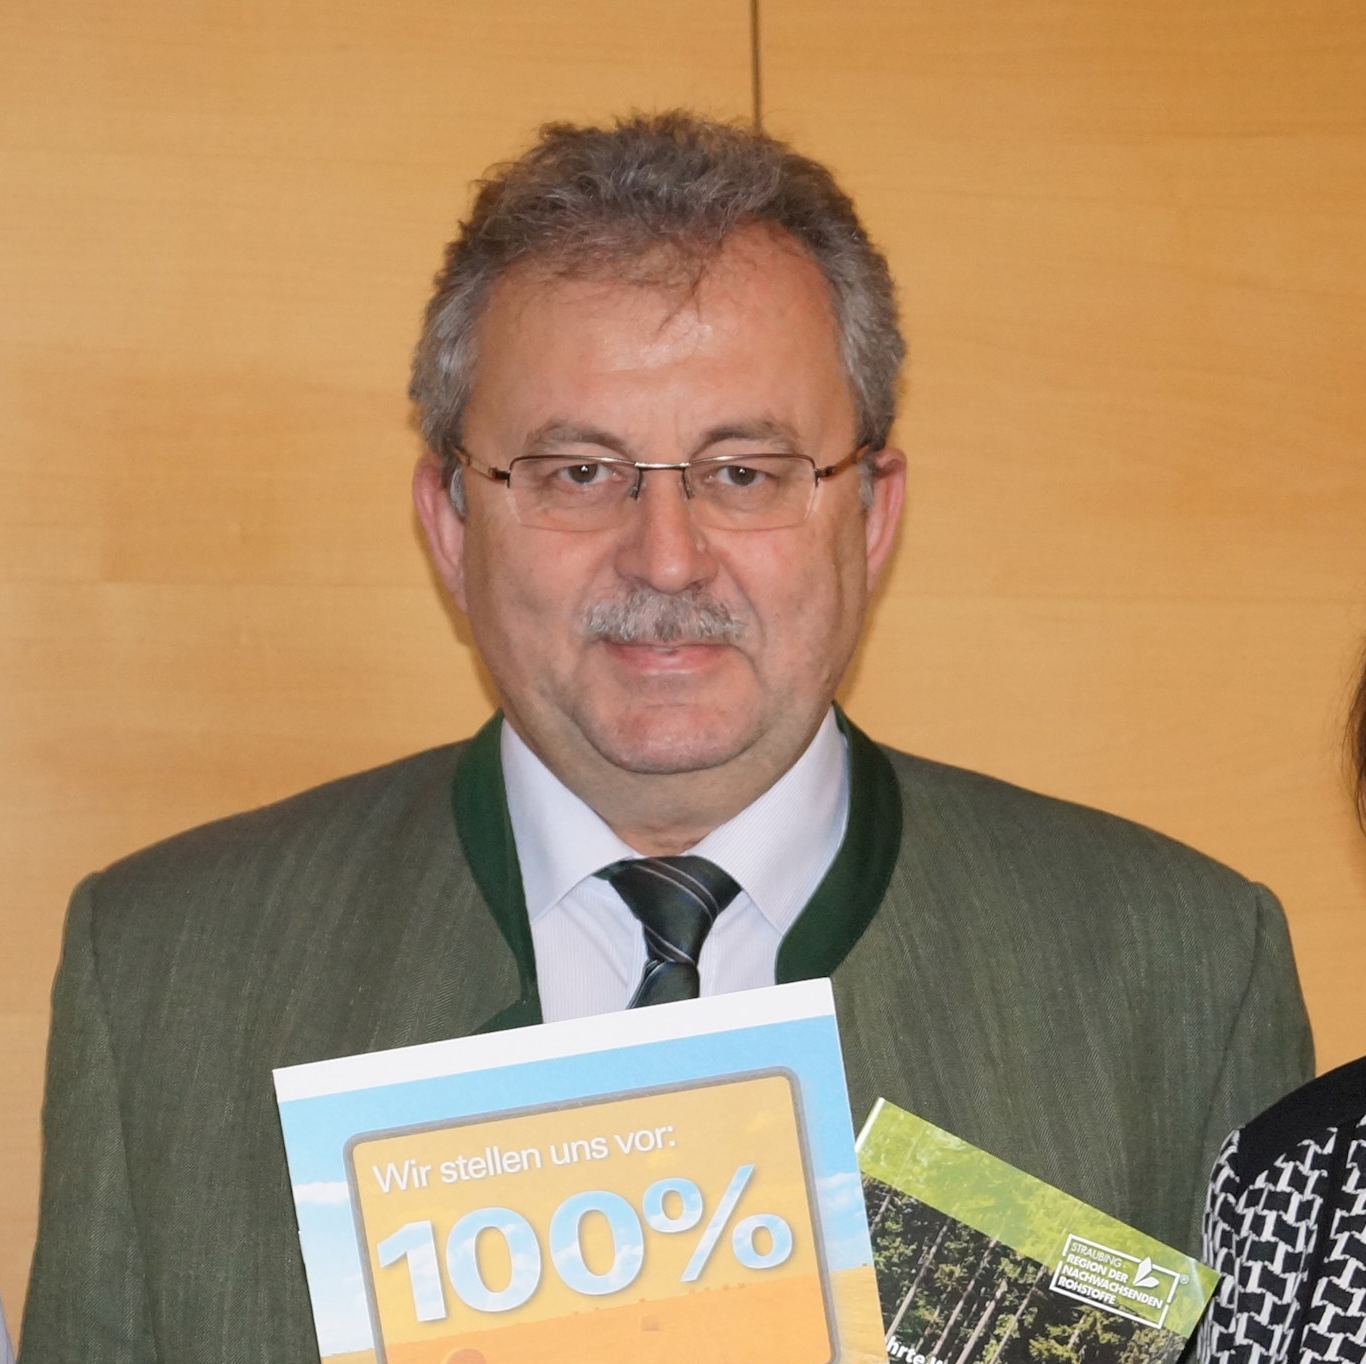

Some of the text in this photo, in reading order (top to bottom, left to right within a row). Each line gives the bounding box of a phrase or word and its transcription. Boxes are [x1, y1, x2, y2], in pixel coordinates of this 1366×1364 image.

[372, 1124, 676, 1193] Wir stellen uns vor:
[376, 1164, 793, 1322] 100%
[1071, 1243, 1122, 1268] STRAUBING
[1066, 1253, 1128, 1283] REGION DER
[1057, 1276, 1116, 1305] ROHSTOFFE
[1062, 1265, 1163, 1309] NACHWACHSENDEN
